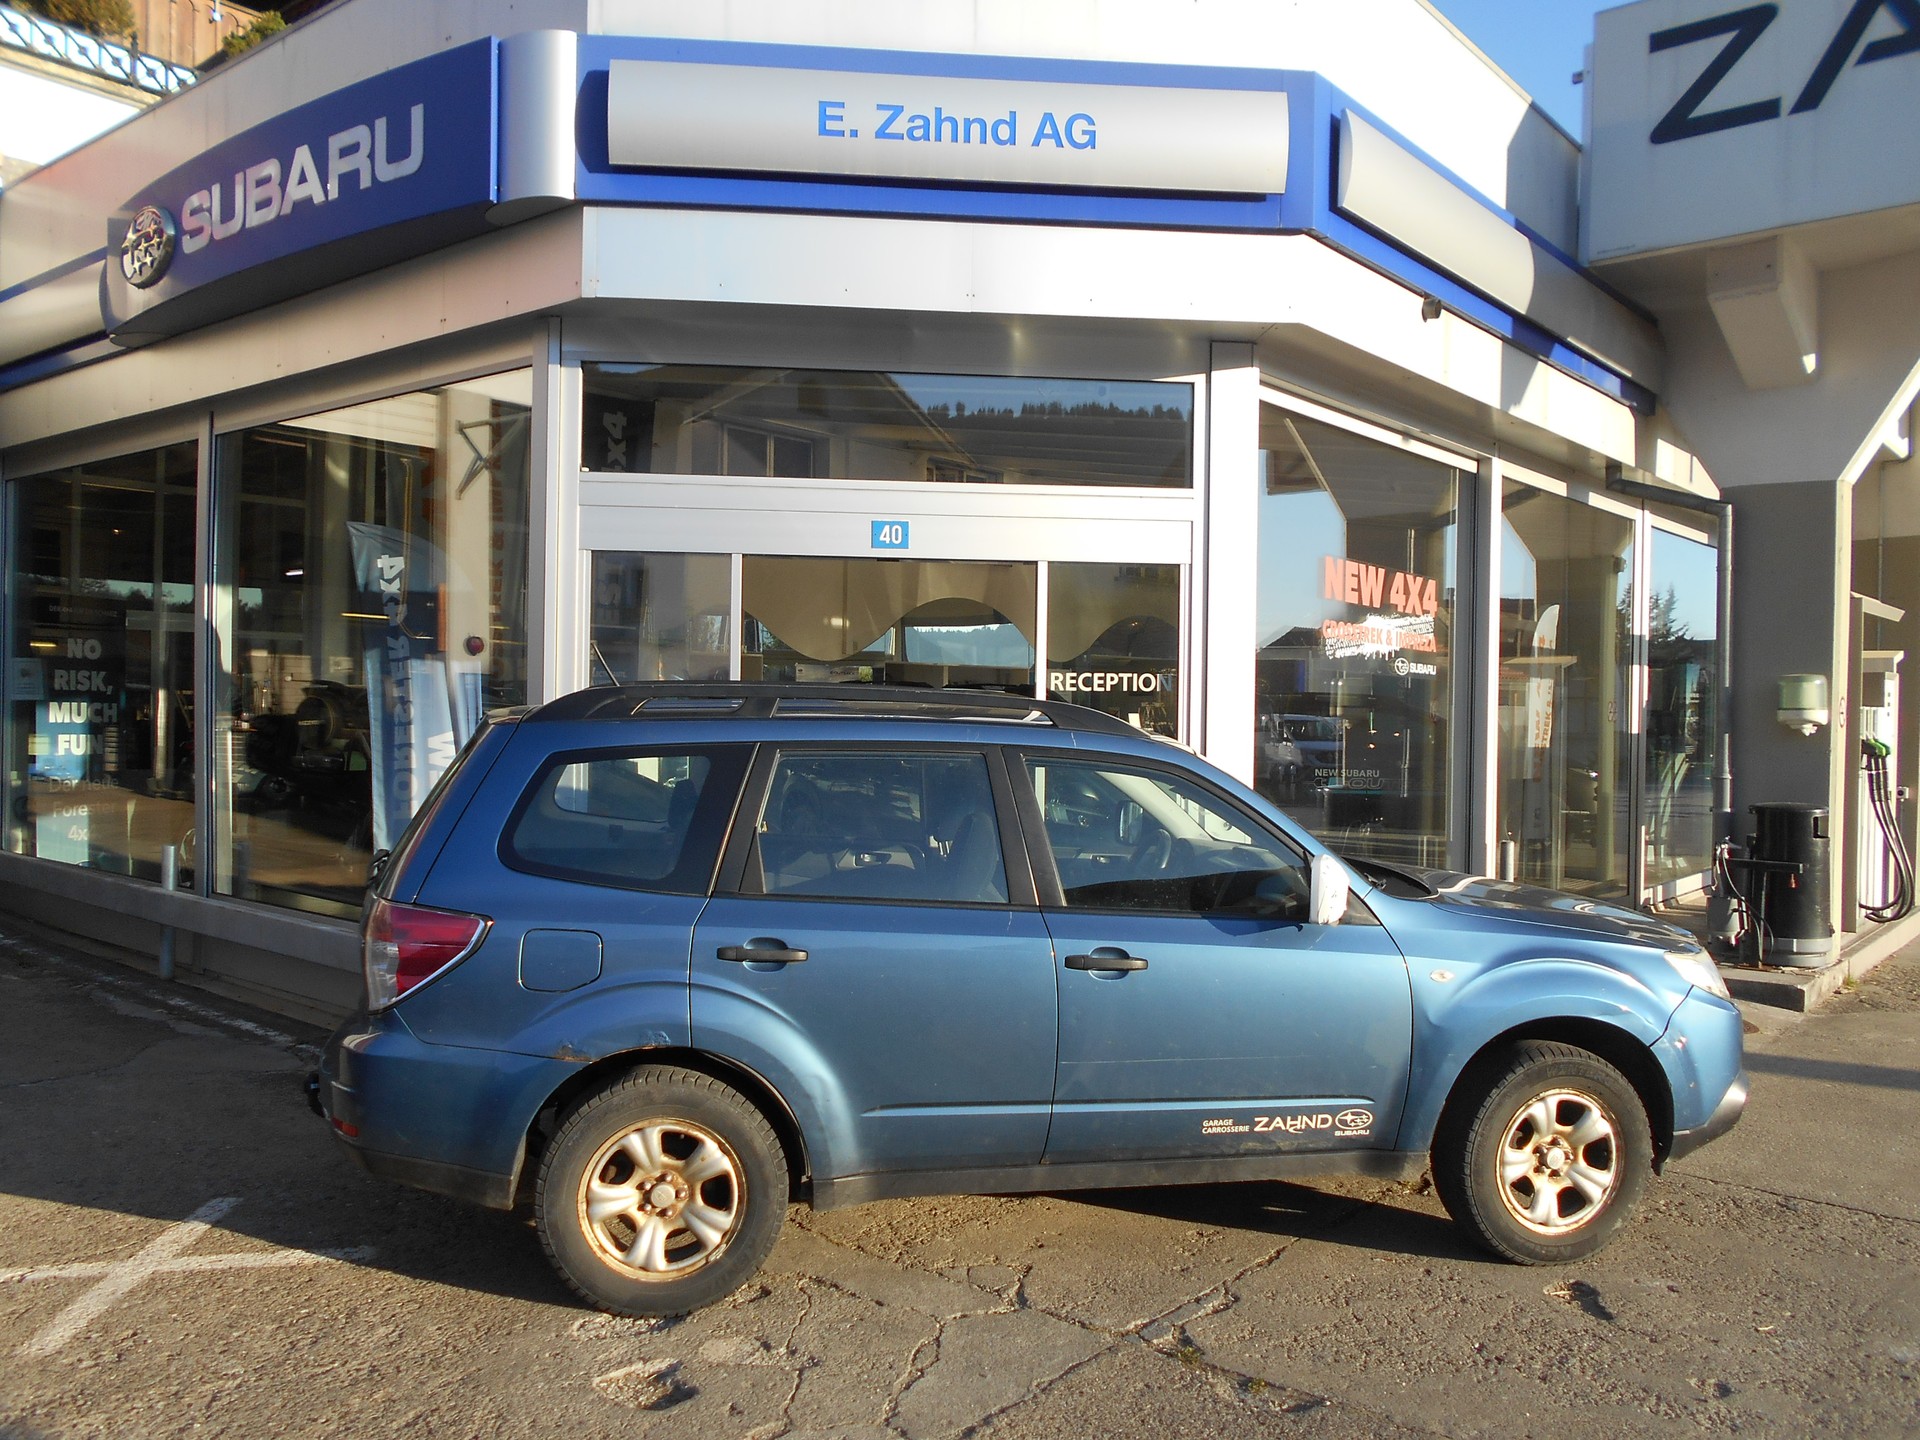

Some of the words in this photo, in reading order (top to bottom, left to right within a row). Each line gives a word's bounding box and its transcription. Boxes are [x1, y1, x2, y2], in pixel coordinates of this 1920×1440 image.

[817, 100, 859, 138] E.
[875, 103, 1017, 148] Zahnd
[1032, 112, 1098, 151] AG
[181, 103, 425, 255] SUBARU
[879, 524, 903, 546] 40
[1324, 554, 1386, 608] NEW
[1389, 571, 1438, 618] 4X4
[1322, 619, 1384, 646] CROSSTREK
[1385, 629, 1393, 646] &
[1396, 630, 1437, 653] IMPREZA
[67, 638, 102, 661] NO
[1409, 662, 1437, 675] SUBARU
[54, 669, 114, 695] RISK,
[1050, 672, 1173, 692] RECEPTION
[48, 701, 118, 725] MUCH
[57, 734, 104, 757] FUN
[1314, 768, 1337, 777] NEW
[1341, 769, 1380, 778] SUBARU
[48, 776, 78, 793] Der
[1202, 1125, 1250, 1134] CARROSSERIE
[1203, 1119, 1234, 1127] GARAGE
[1253, 1113, 1333, 1134] ZAHND
[1334, 1129, 1370, 1137] SUBARU
